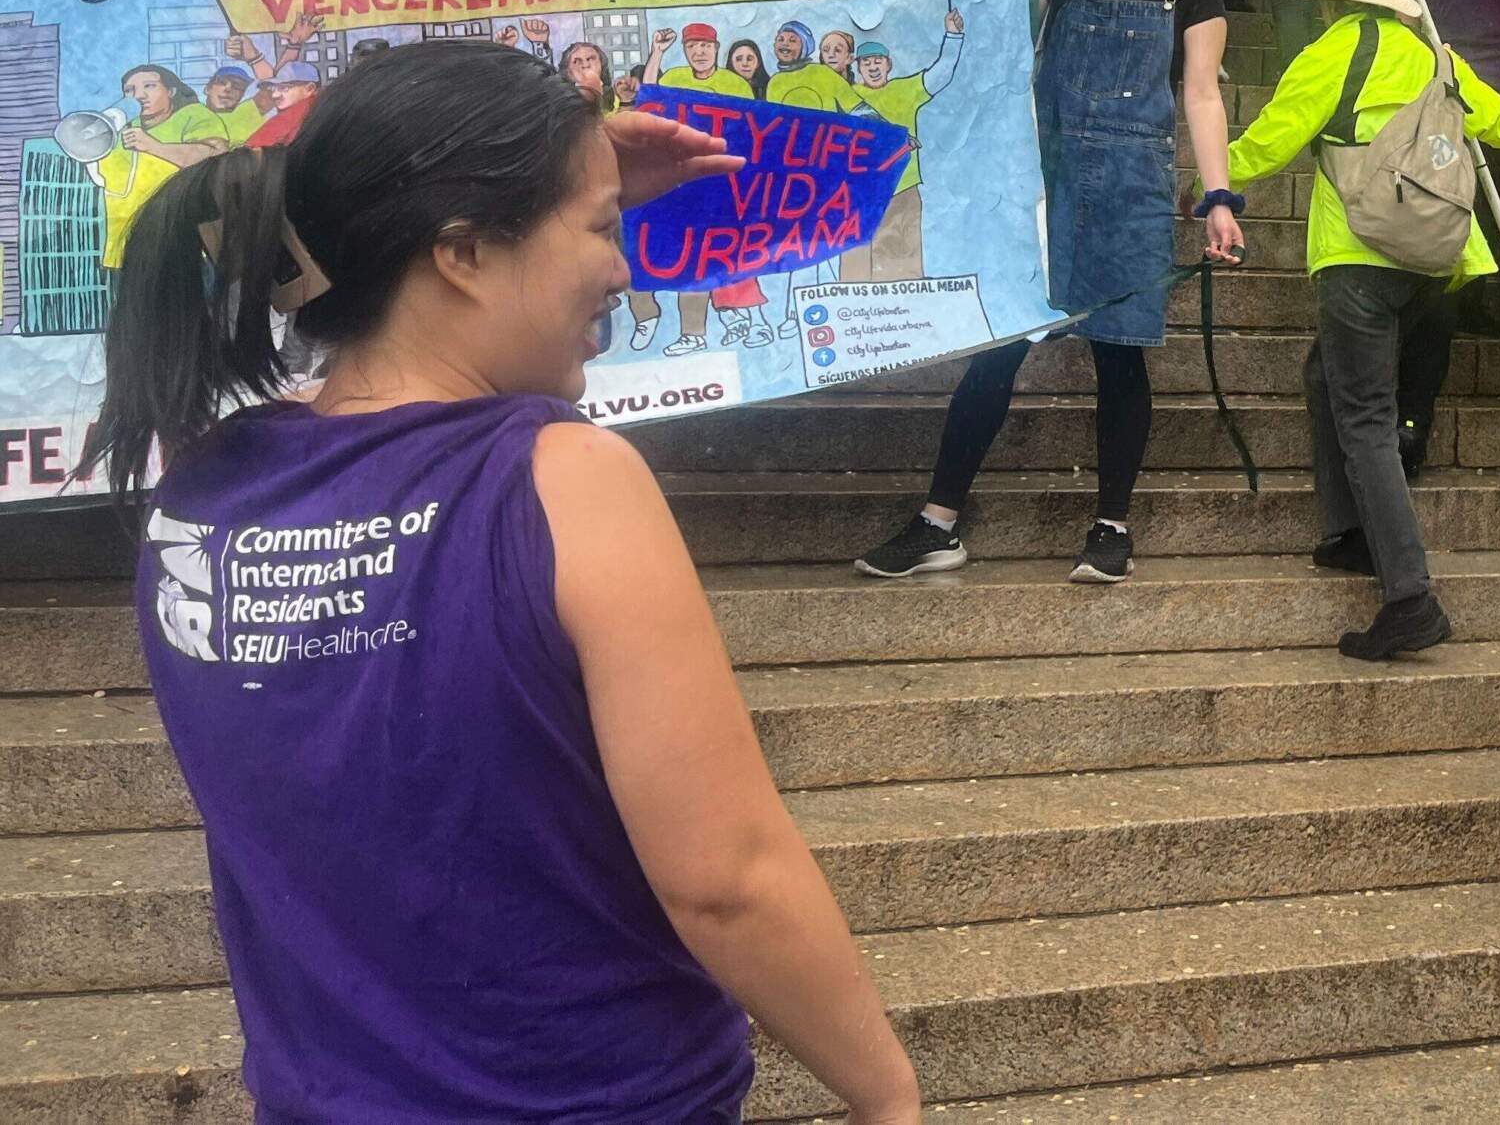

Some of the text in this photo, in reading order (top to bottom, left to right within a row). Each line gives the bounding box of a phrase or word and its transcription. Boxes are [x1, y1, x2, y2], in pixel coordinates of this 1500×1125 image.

[728, 172, 853, 221] VIDA
[638, 210, 863, 281] URBANA
[801, 278, 974, 302] FOLLOW US ON SOCIAL MEDIA
[0, 426, 66, 486] FE
[235, 502, 440, 555] Commite of
[232, 589, 365, 624] Residents
